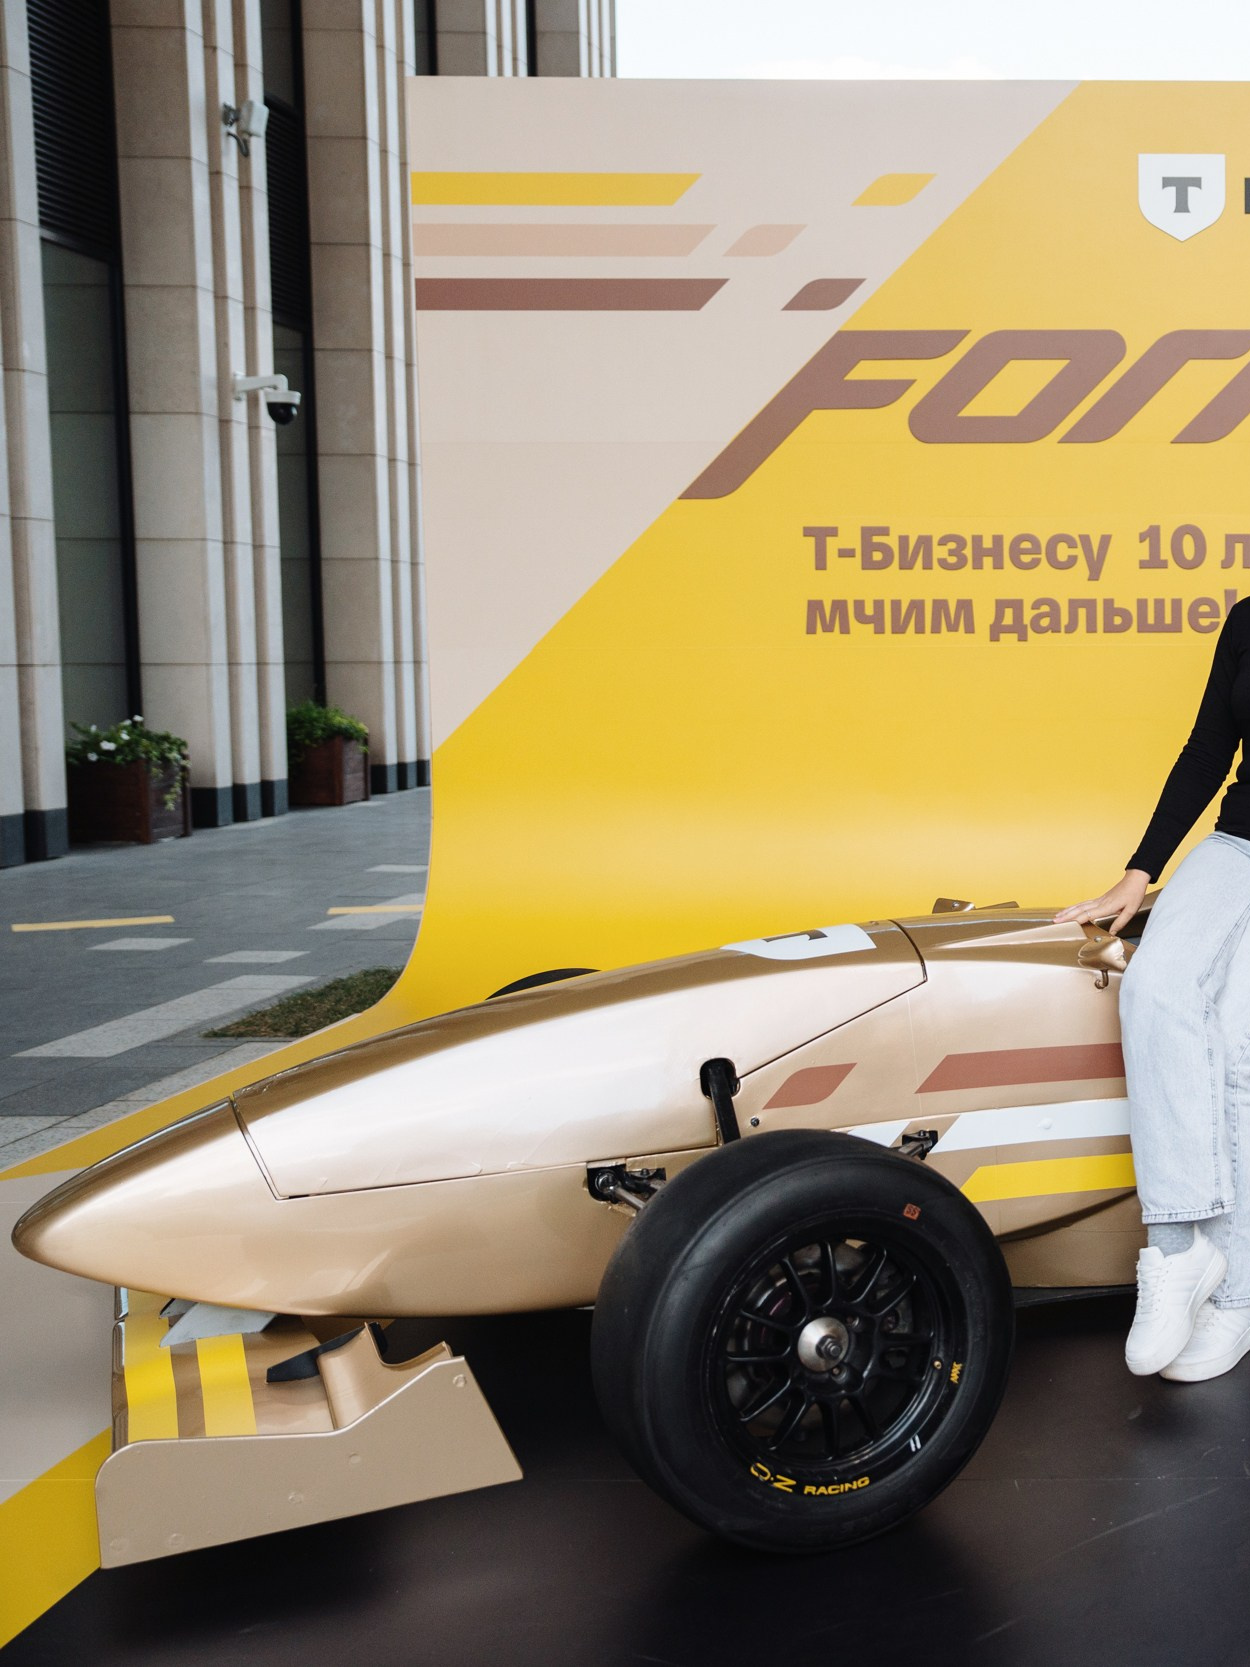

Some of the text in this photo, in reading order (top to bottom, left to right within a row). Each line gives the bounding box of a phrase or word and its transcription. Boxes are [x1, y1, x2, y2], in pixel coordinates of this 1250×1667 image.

[802, 525, 1113, 582] Т-Бизнесу
[1138, 523, 1208, 571] 10
[805, 598, 976, 635] мчим
[803, 1476, 871, 1496] RACING
